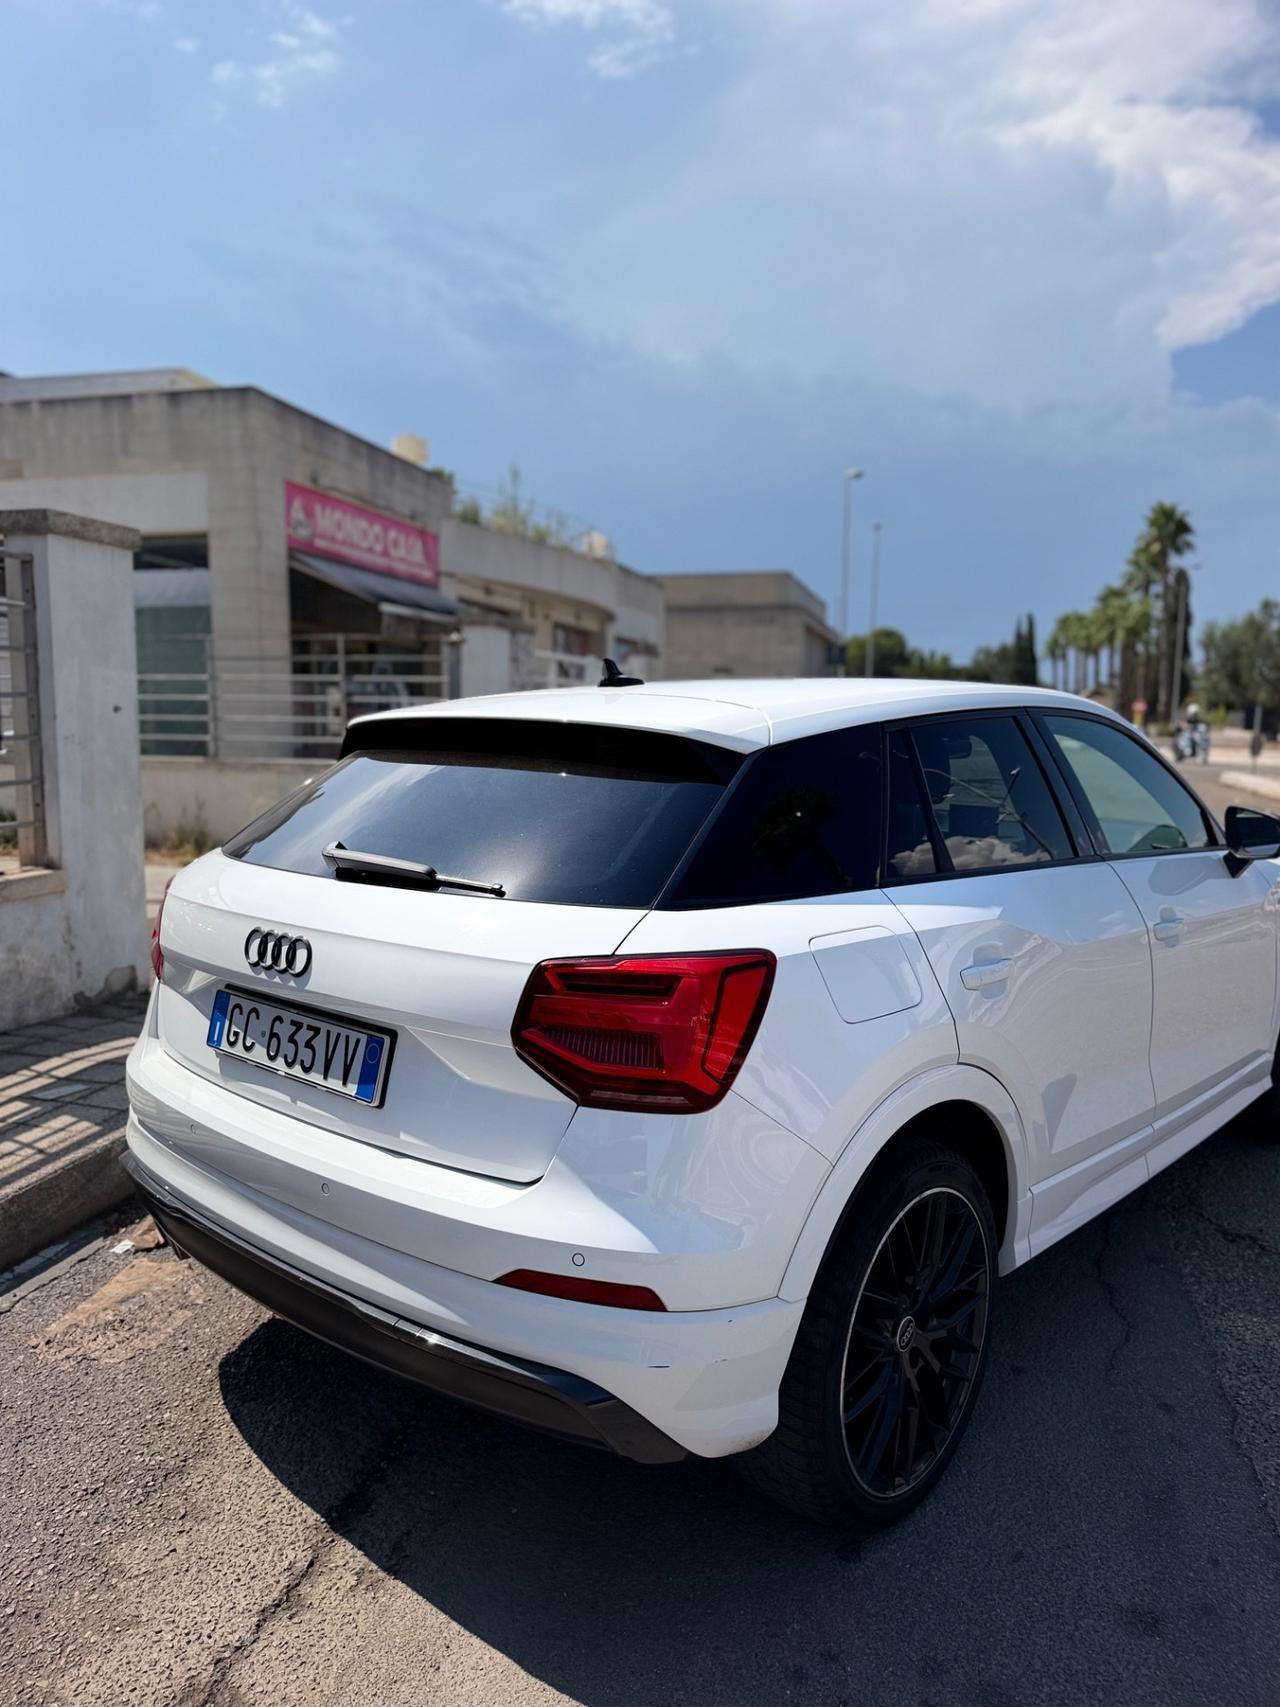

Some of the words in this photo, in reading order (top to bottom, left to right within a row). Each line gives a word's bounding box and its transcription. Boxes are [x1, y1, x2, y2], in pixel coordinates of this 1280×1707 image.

[314, 503, 384, 553] MONDO
[227, 1003, 260, 1052] GC
[266, 1015, 361, 1087] 633VV
